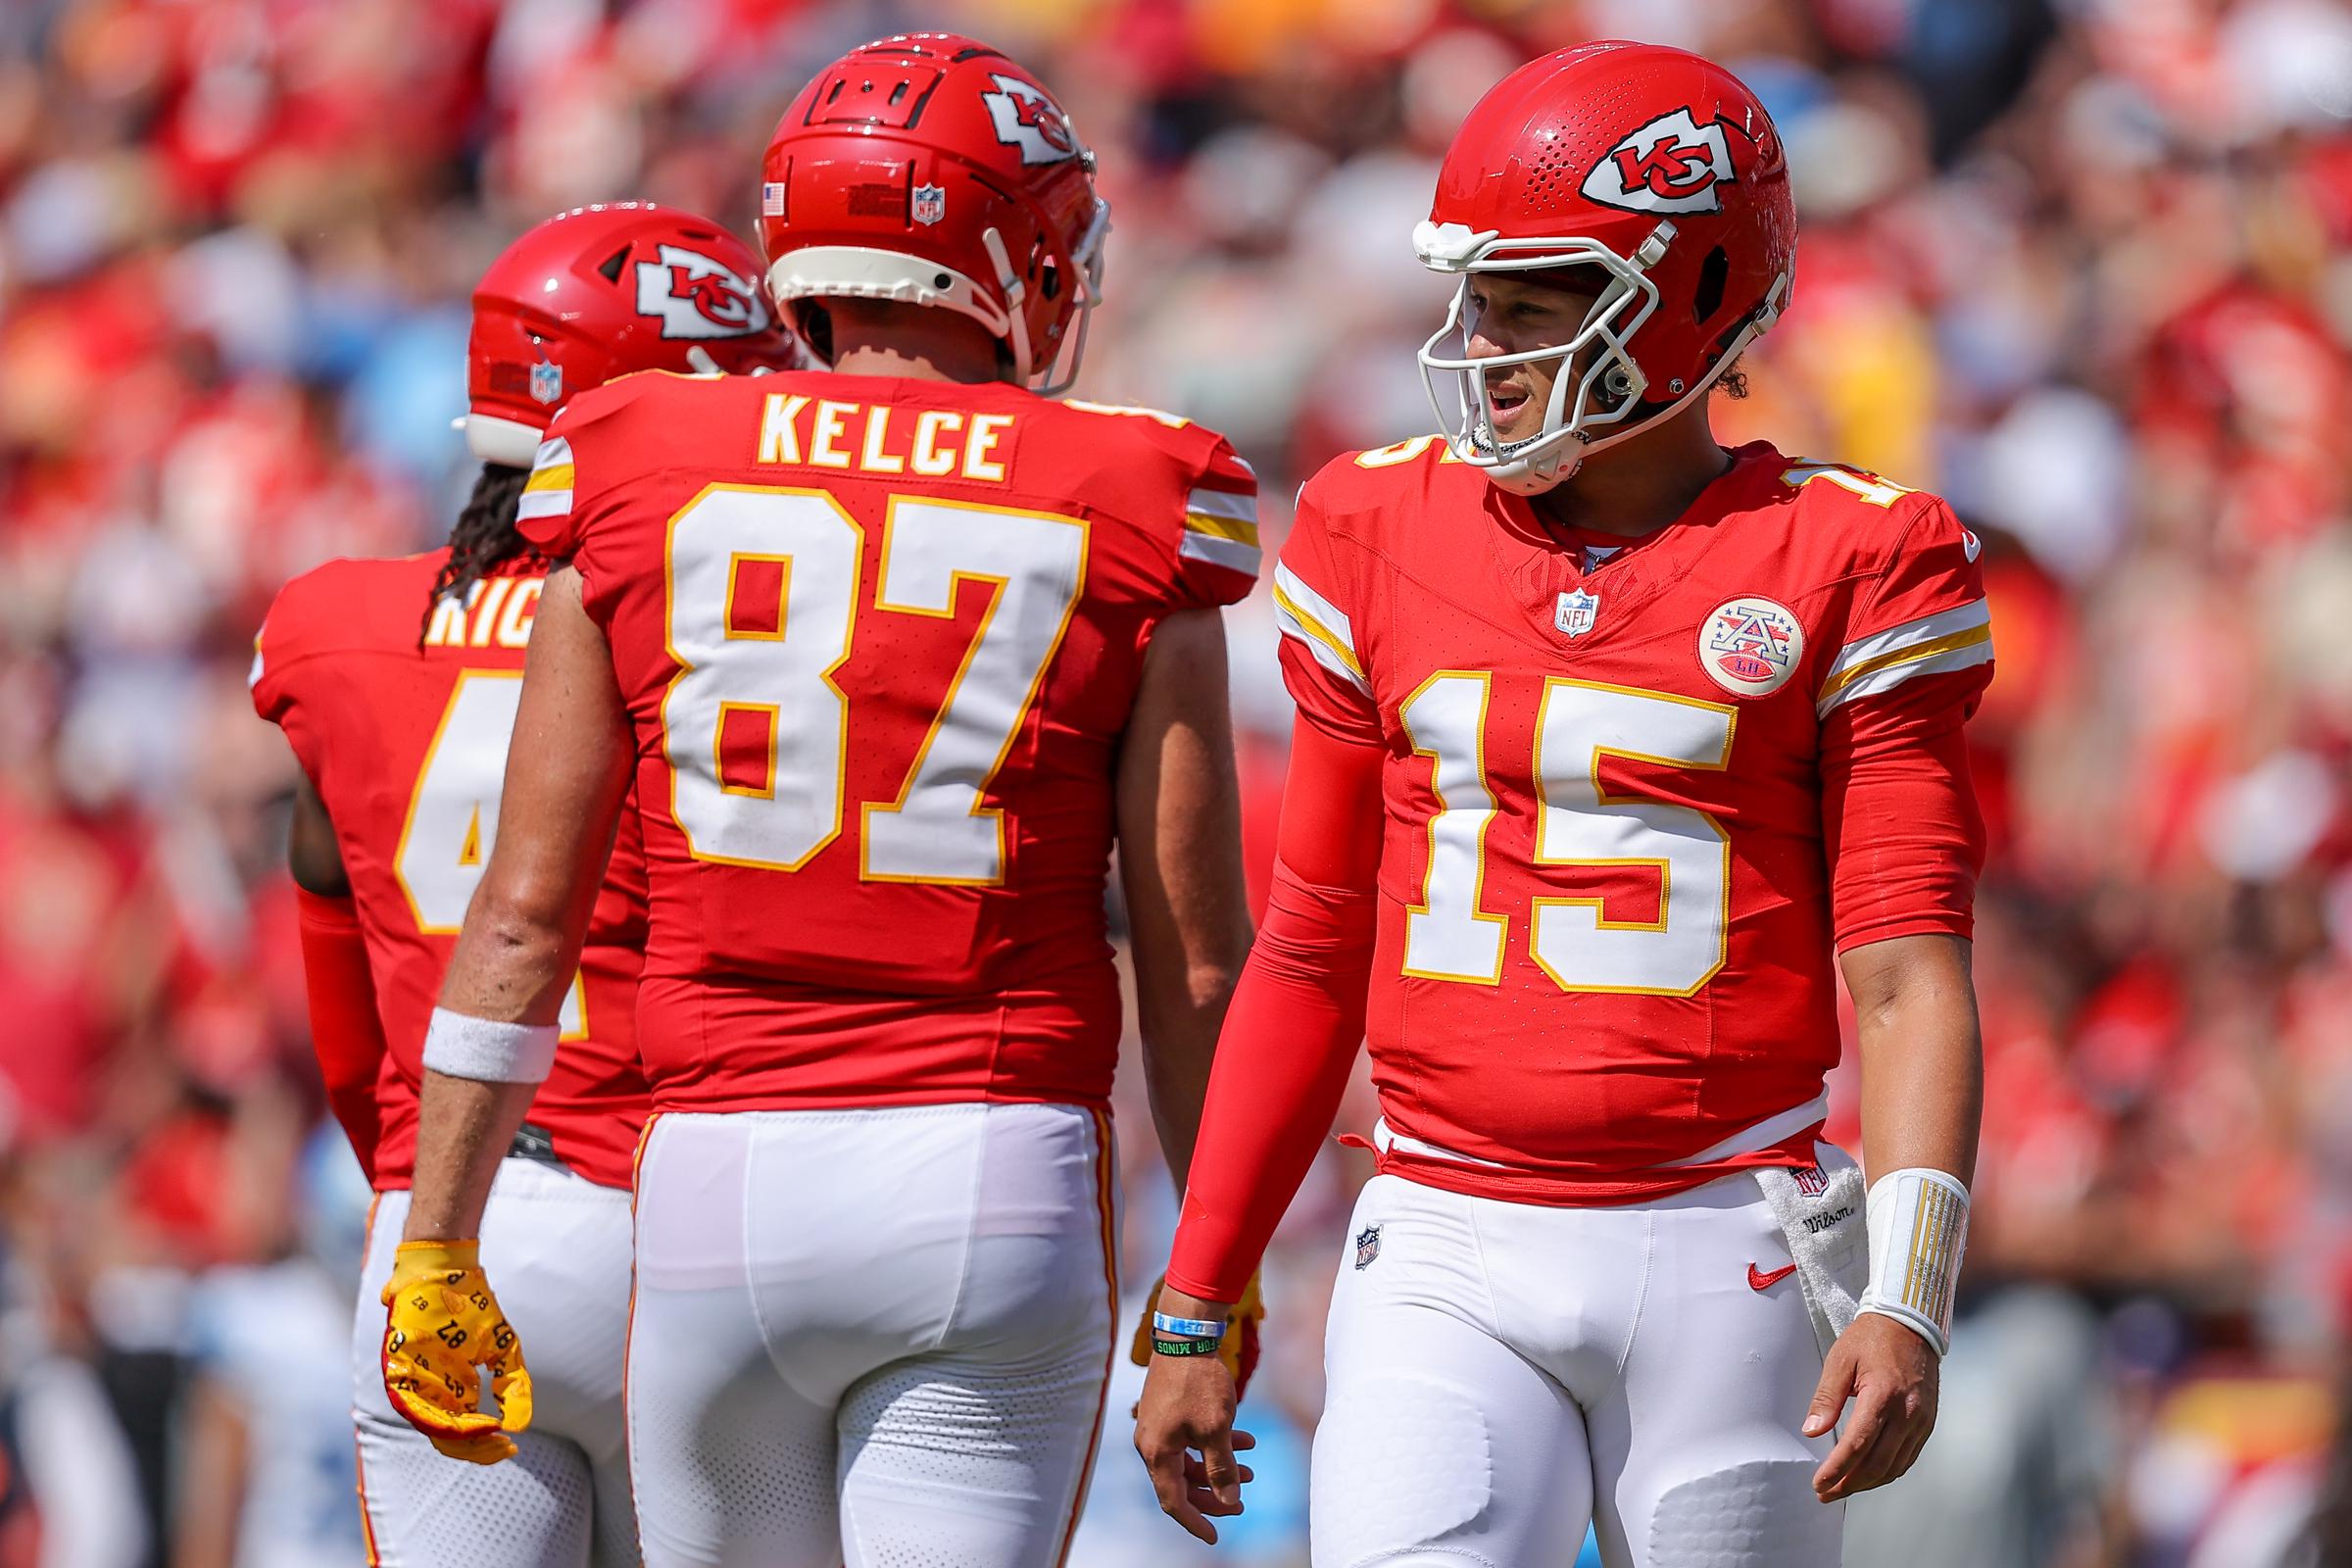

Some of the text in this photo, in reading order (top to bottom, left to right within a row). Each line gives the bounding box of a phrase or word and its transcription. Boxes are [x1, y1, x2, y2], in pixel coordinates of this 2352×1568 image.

[1610, 134, 1717, 199] KC
[667, 265, 752, 327] KC
[757, 392, 1014, 482] KELCE
[1561, 610, 1588, 628] NFL
[661, 481, 1092, 887] 87
[1398, 669, 1740, 998] 15
[1793, 1167, 1828, 1195] NFL
[1802, 1206, 1849, 1234] Wilson
[469, 1289, 489, 1311] 87
[437, 1318, 467, 1349] 87
